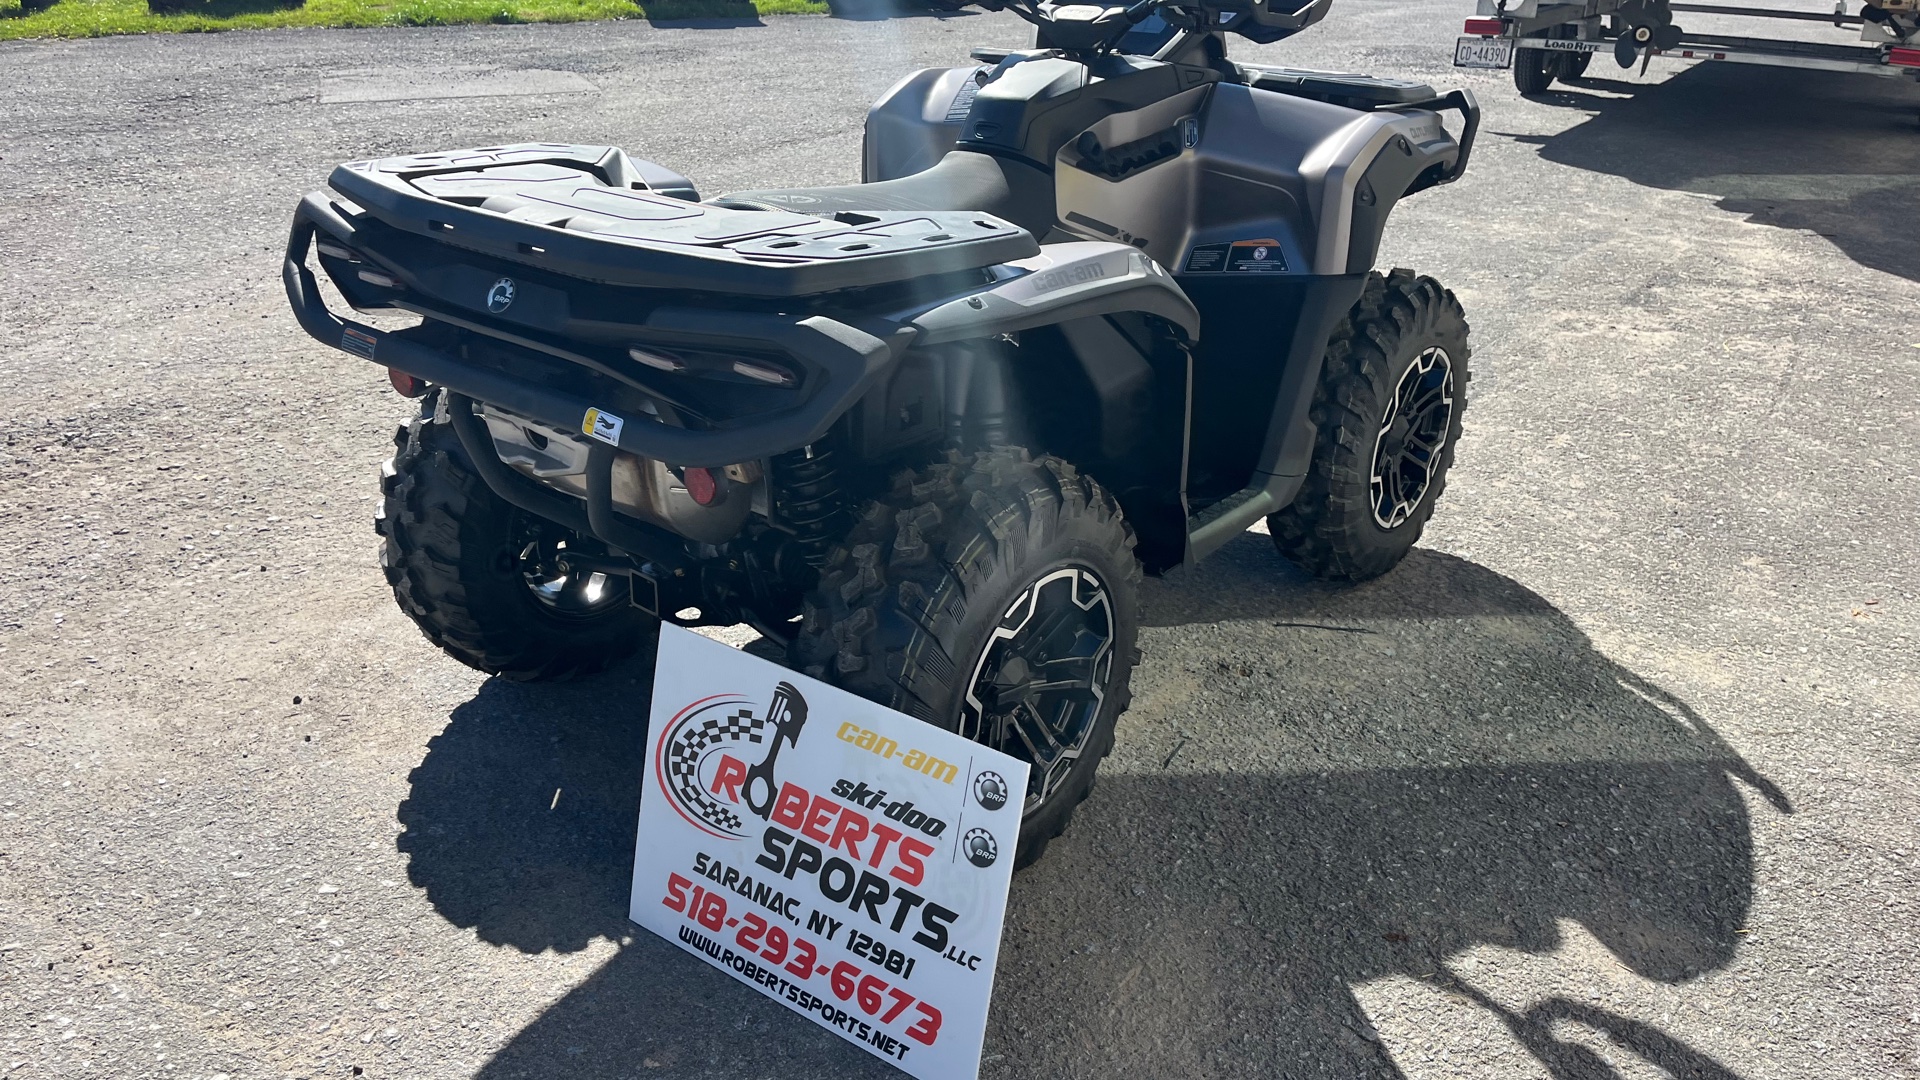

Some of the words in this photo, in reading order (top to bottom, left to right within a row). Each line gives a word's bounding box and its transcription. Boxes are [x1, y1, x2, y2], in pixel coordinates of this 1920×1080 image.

[494, 295, 510, 303] BRP
[1031, 261, 1104, 291] can-am
[836, 721, 958, 784] can-am
[711, 754, 935, 888] ROBERTS
[830, 778, 947, 838] ski-doo
[986, 791, 1006, 803] BRP
[976, 849, 996, 860] BRP
[692, 851, 801, 927] SARANAC,
[807, 909, 844, 941] NY
[845, 928, 916, 980] 12981
[662, 872, 943, 1046] 518-293-6673
